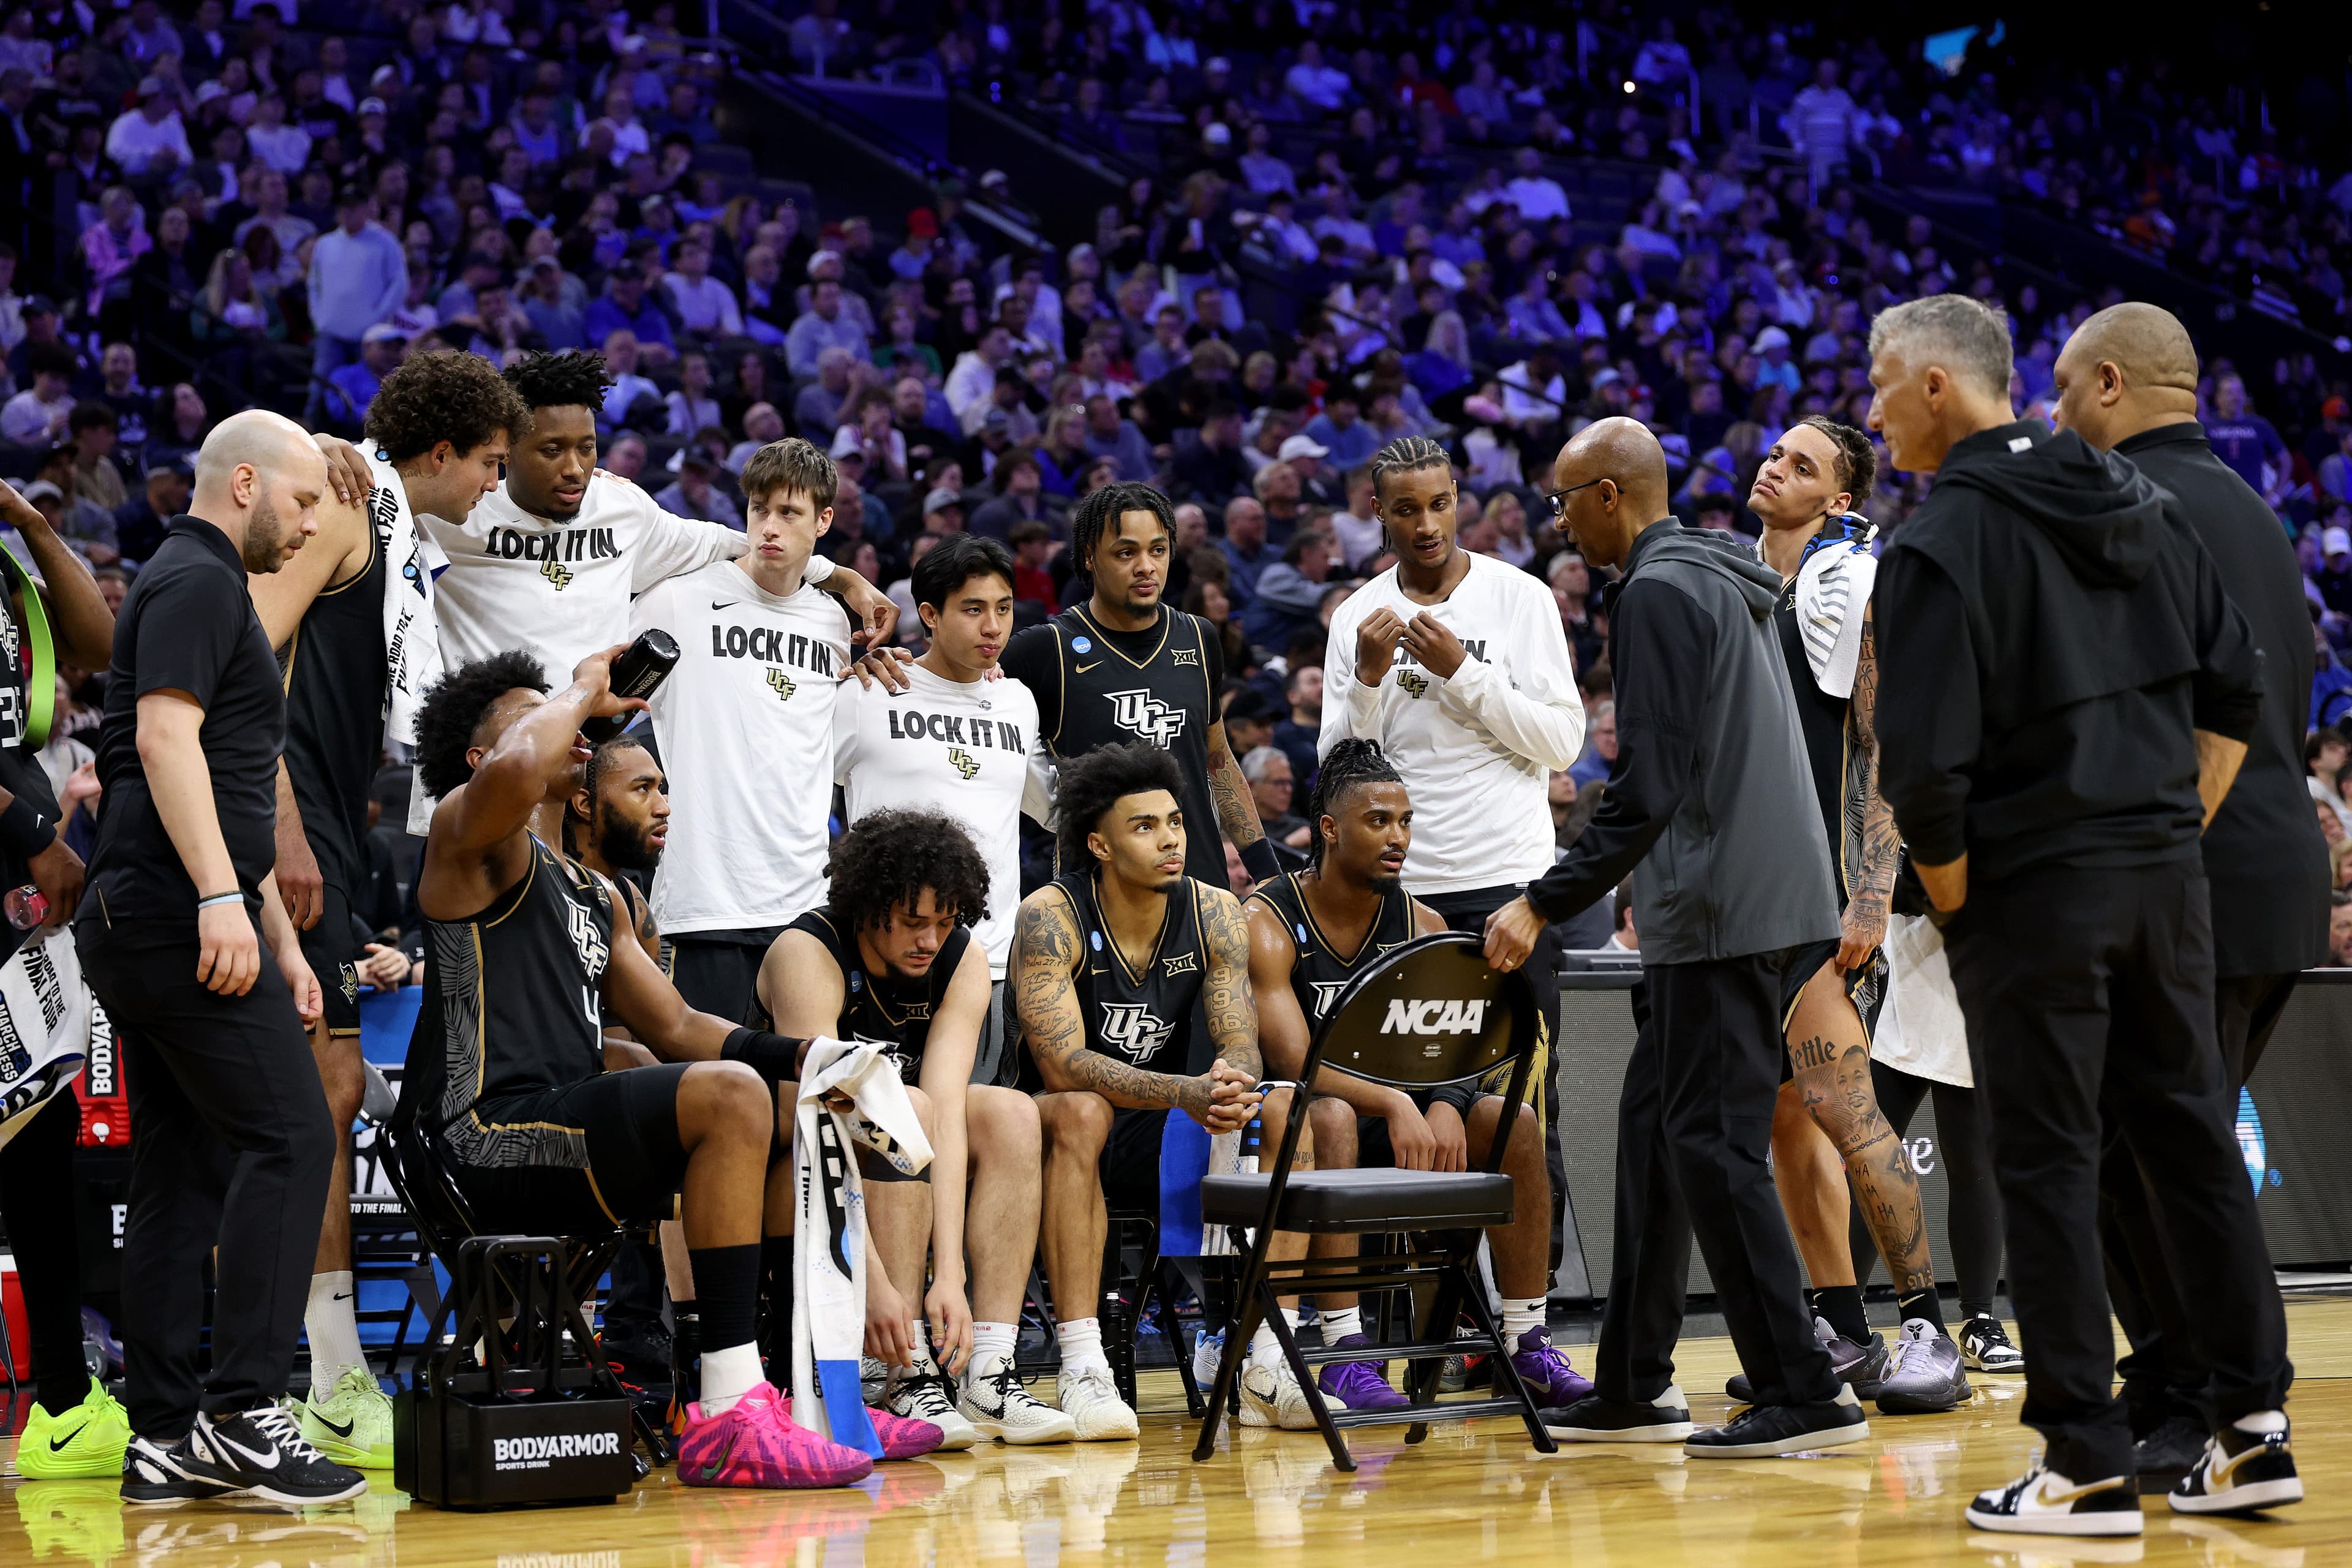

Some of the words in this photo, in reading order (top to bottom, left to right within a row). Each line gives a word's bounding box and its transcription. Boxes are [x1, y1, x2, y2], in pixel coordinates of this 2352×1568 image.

[485, 526, 561, 562] LOCK
[565, 529, 587, 562] IT
[540, 560, 574, 591] UCF
[388, 633, 404, 665] ROAD
[712, 625, 784, 664] LOCK
[788, 633, 809, 668] IT
[811, 640, 834, 679] IN.
[767, 666, 796, 701] UCF
[1397, 669, 1428, 698] UCF
[889, 710, 967, 744] LOCK
[970, 718, 993, 747] IT
[998, 722, 1025, 756] IN.
[1110, 691, 1185, 748] UCF
[948, 747, 980, 780] UCF
[566, 897, 608, 980] UCF
[18, 945, 48, 996] FINAL
[51, 981, 60, 998] TO
[55, 995, 66, 1017] THE
[582, 984, 603, 1050] 4
[1102, 1005, 1173, 1063] UCF
[1379, 999, 1485, 1035] NCAA
[350, 1203, 361, 1213] TO
[363, 1203, 379, 1213] THE
[379, 1203, 402, 1213] FINAL
[494, 1433, 619, 1461] BODYARMOR
